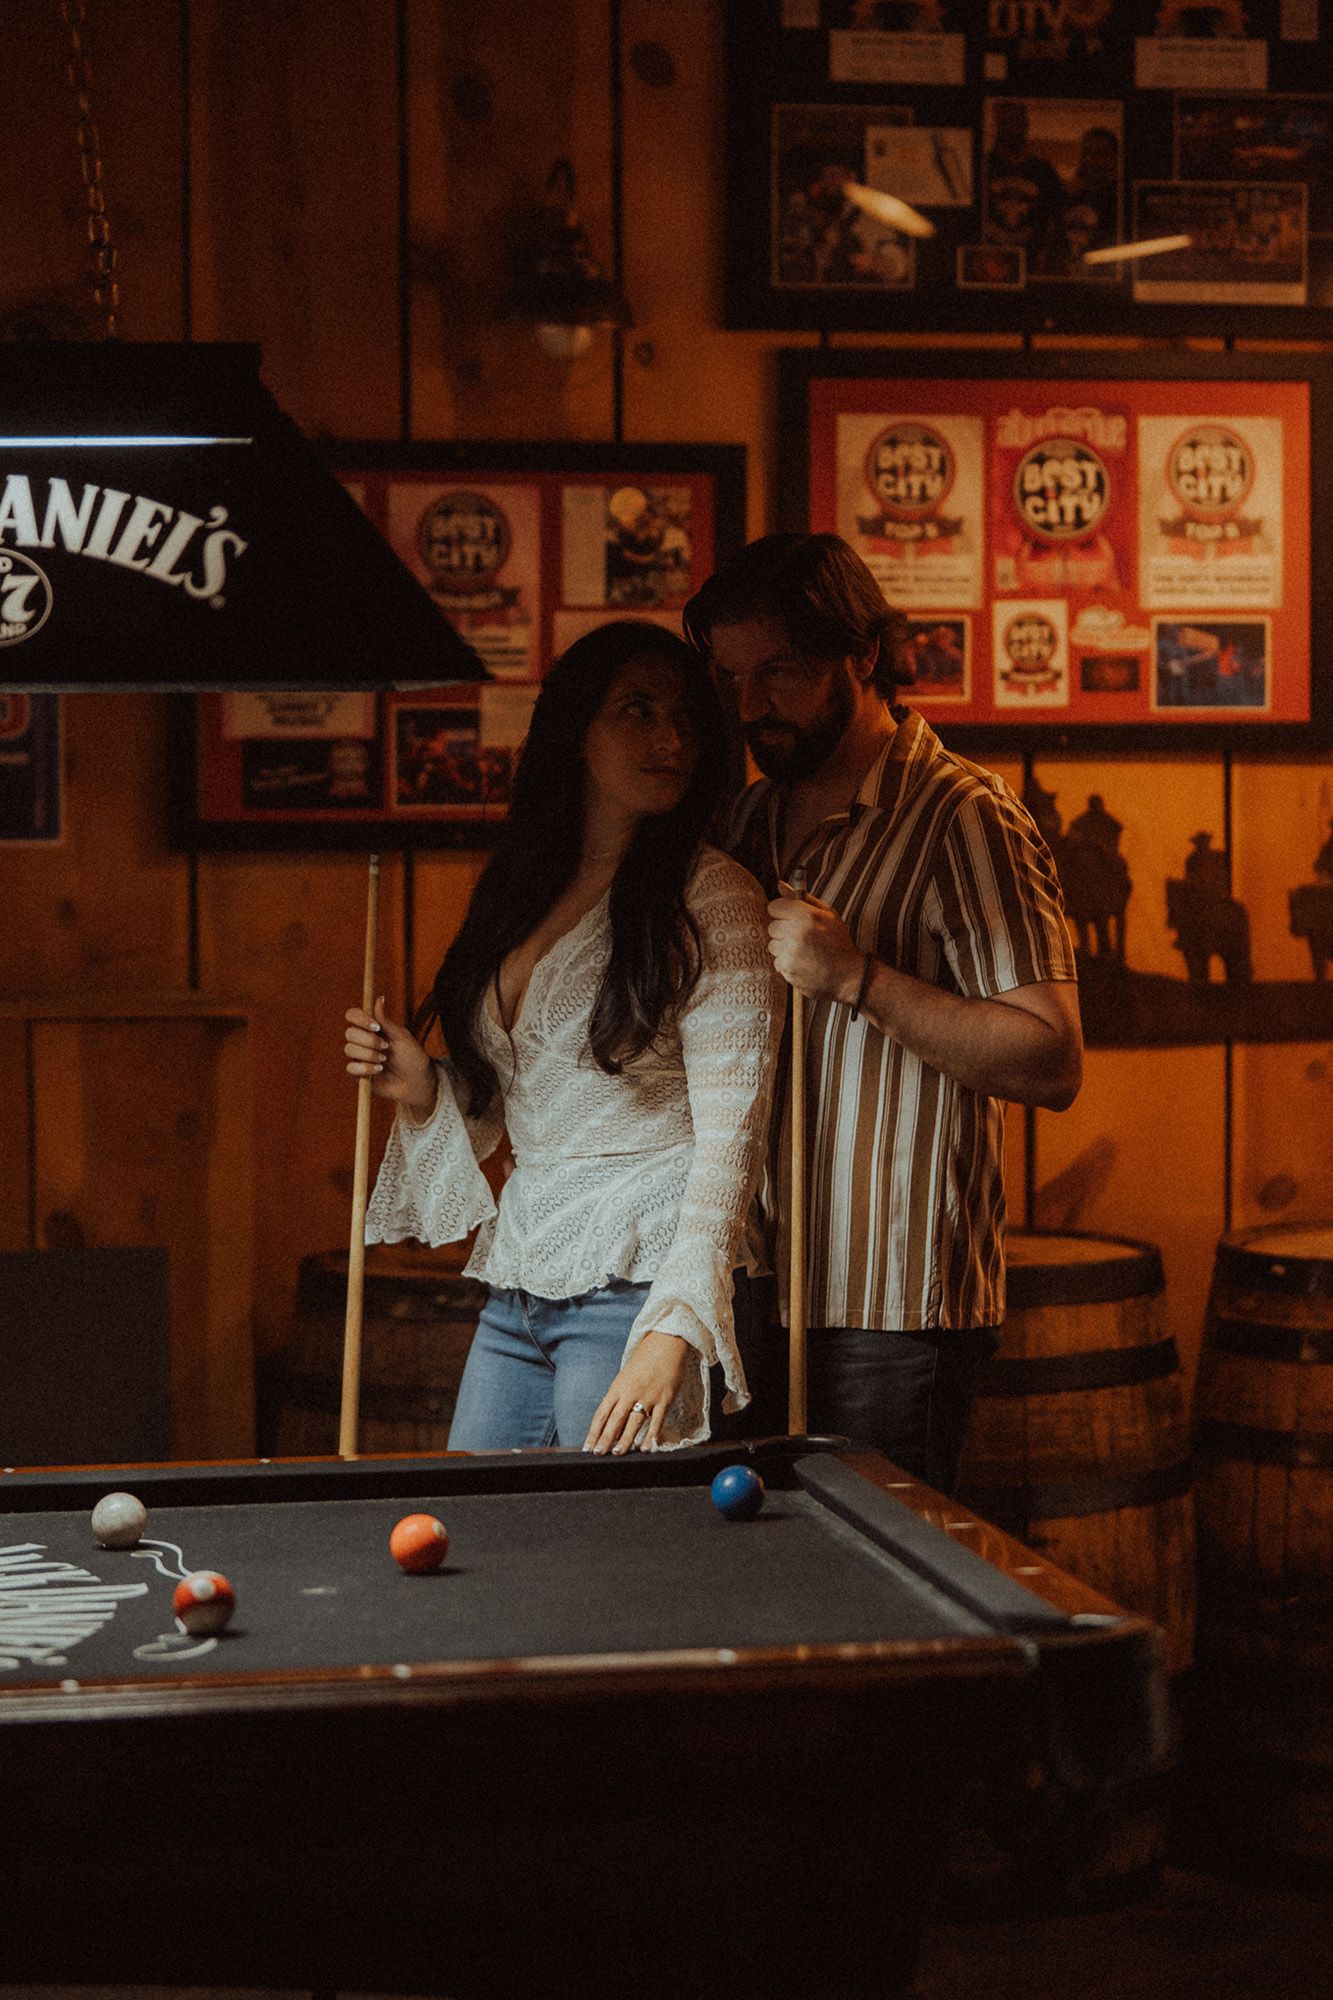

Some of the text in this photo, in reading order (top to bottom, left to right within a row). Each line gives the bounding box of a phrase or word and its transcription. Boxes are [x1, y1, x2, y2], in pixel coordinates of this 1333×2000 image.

[878, 444, 941, 470] BEST
[1179, 445, 1241, 471] BEST
[877, 473, 943, 498] CITY
[1023, 459, 1097, 490] BEST
[1178, 474, 1243, 499] CITY
[1024, 492, 1100, 523] CITY
